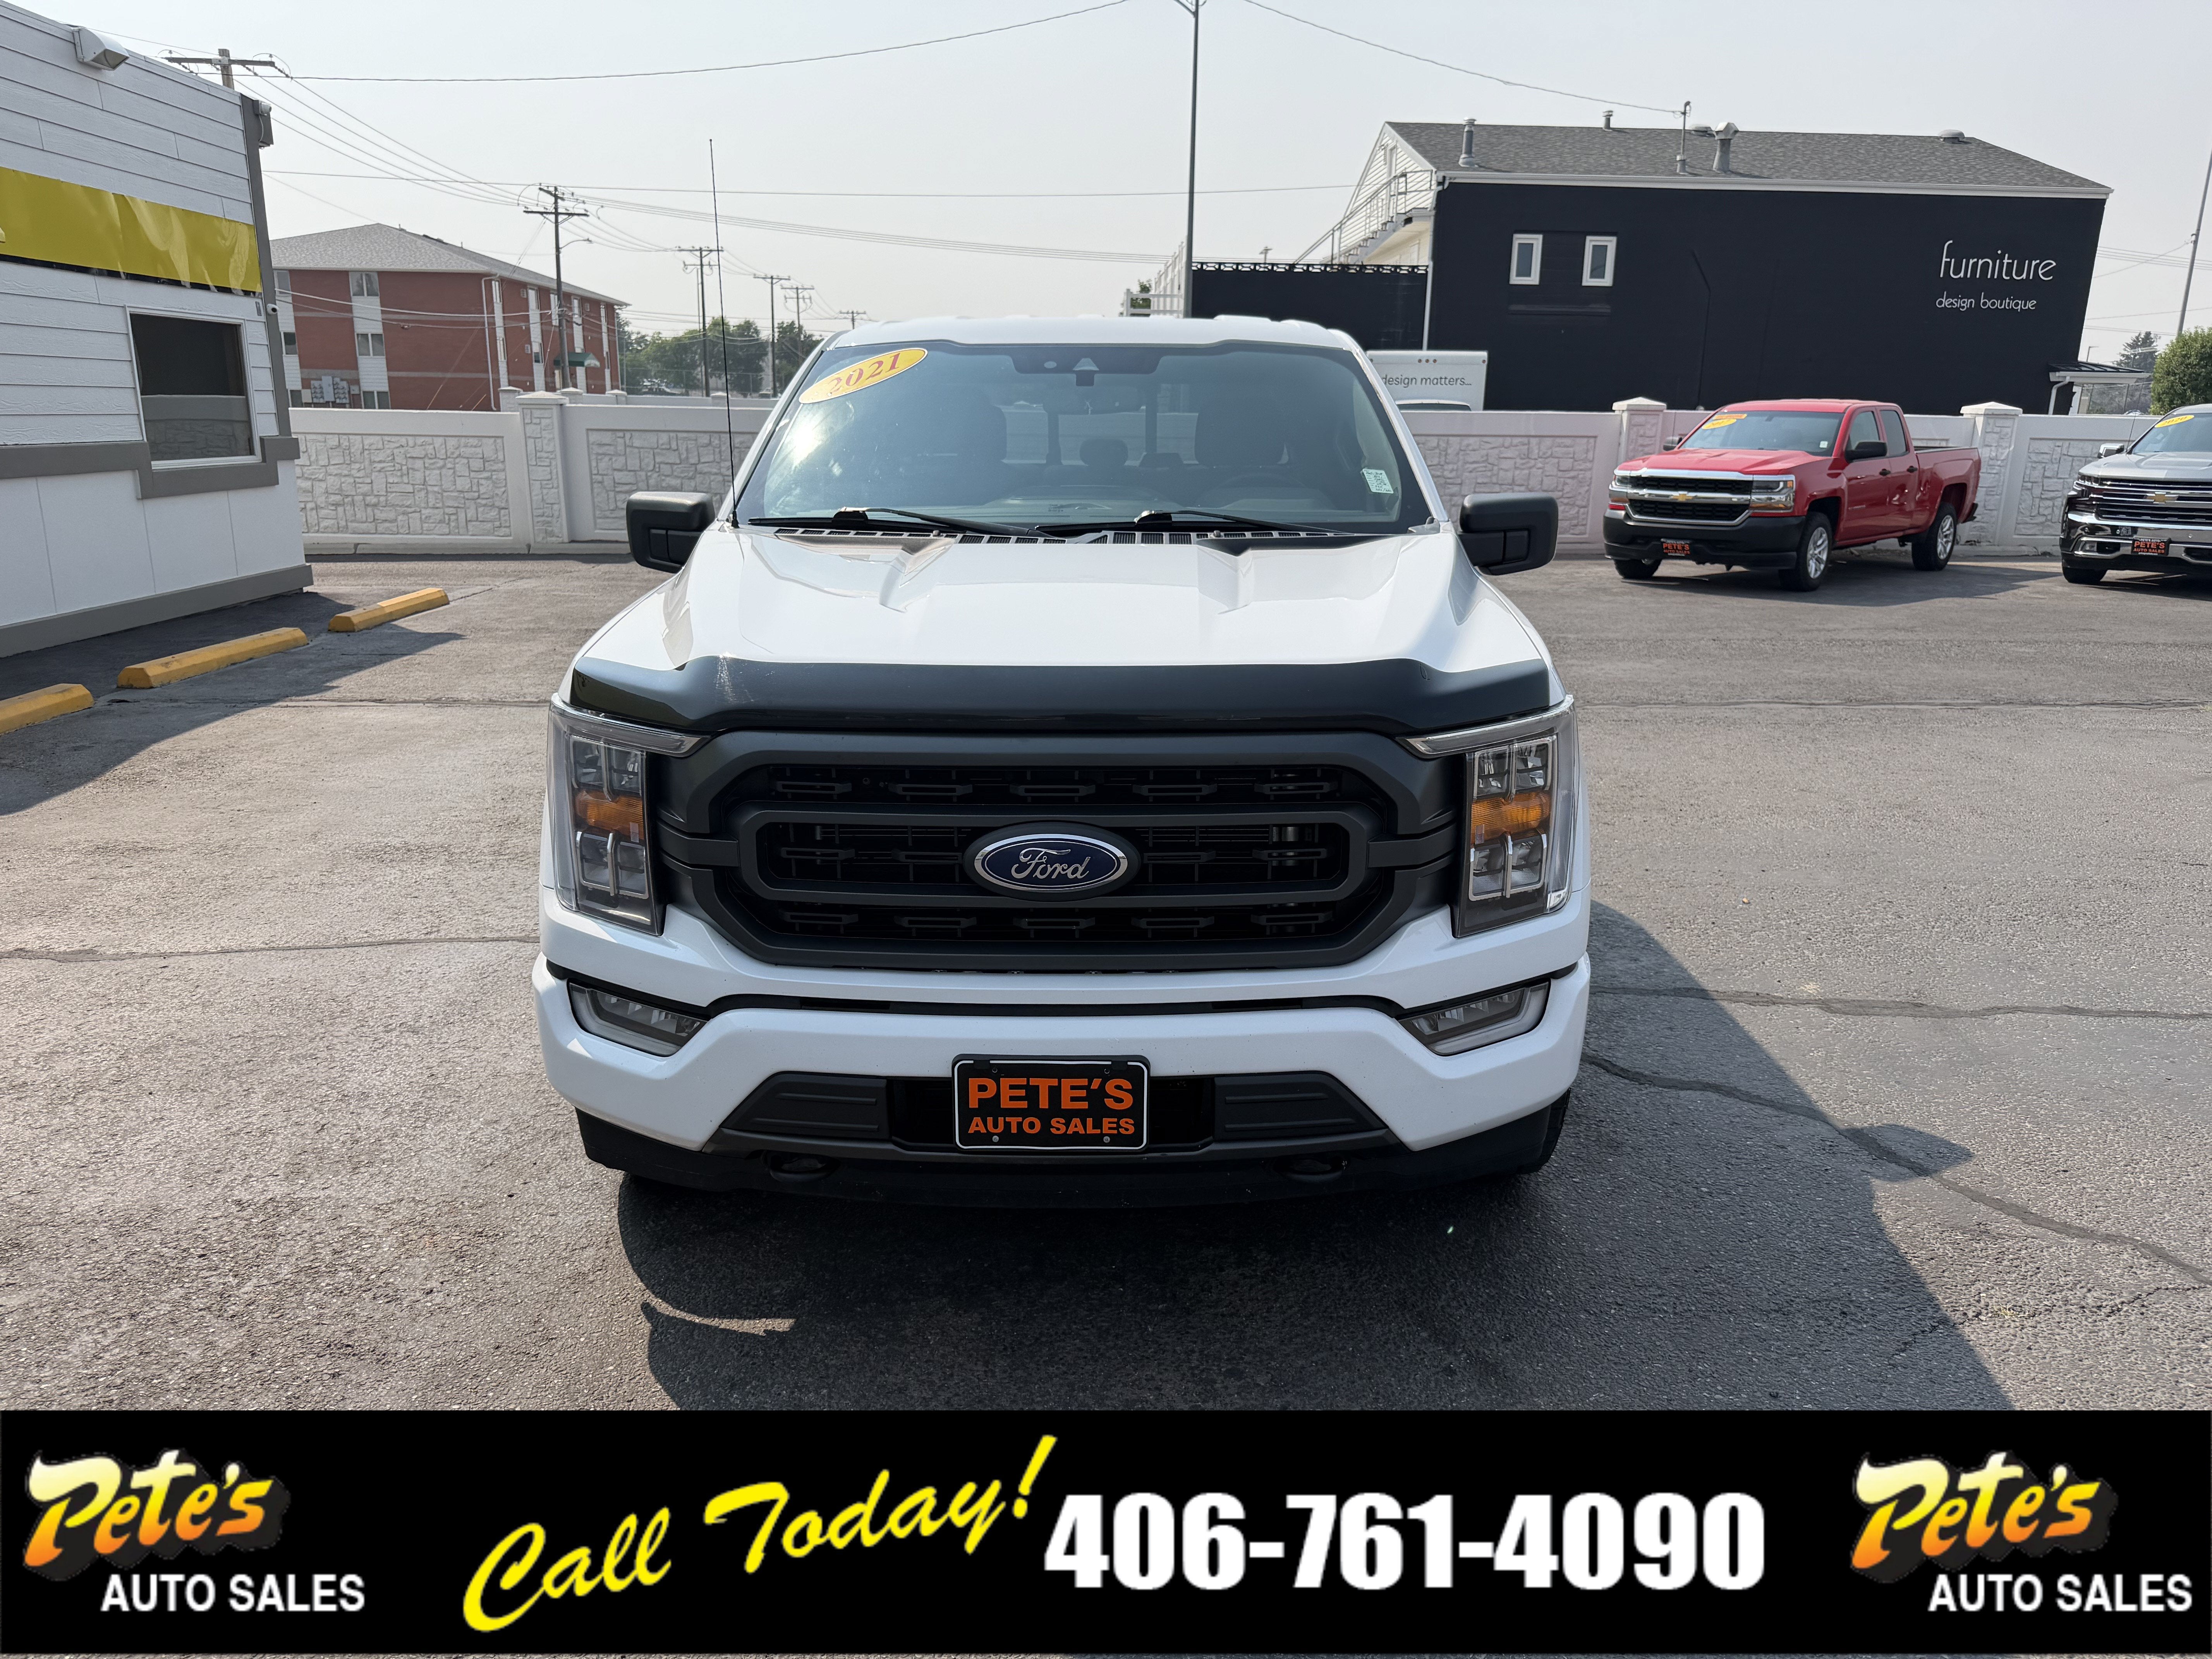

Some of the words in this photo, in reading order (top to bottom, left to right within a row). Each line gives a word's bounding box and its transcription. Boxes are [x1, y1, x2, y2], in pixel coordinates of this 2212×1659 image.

[1940, 240, 2056, 280] furniture
[1936, 291, 1975, 311] design
[1980, 292, 2037, 312] boutique
[827, 353, 901, 394] 2021
[1381, 374, 1417, 388] design
[1420, 376, 1472, 386] matters...
[1011, 848, 1091, 879] Ford
[969, 1078, 1133, 1110] PETE'S
[968, 1117, 1041, 1133] AUTO
[1050, 1118, 1135, 1135] SALES
